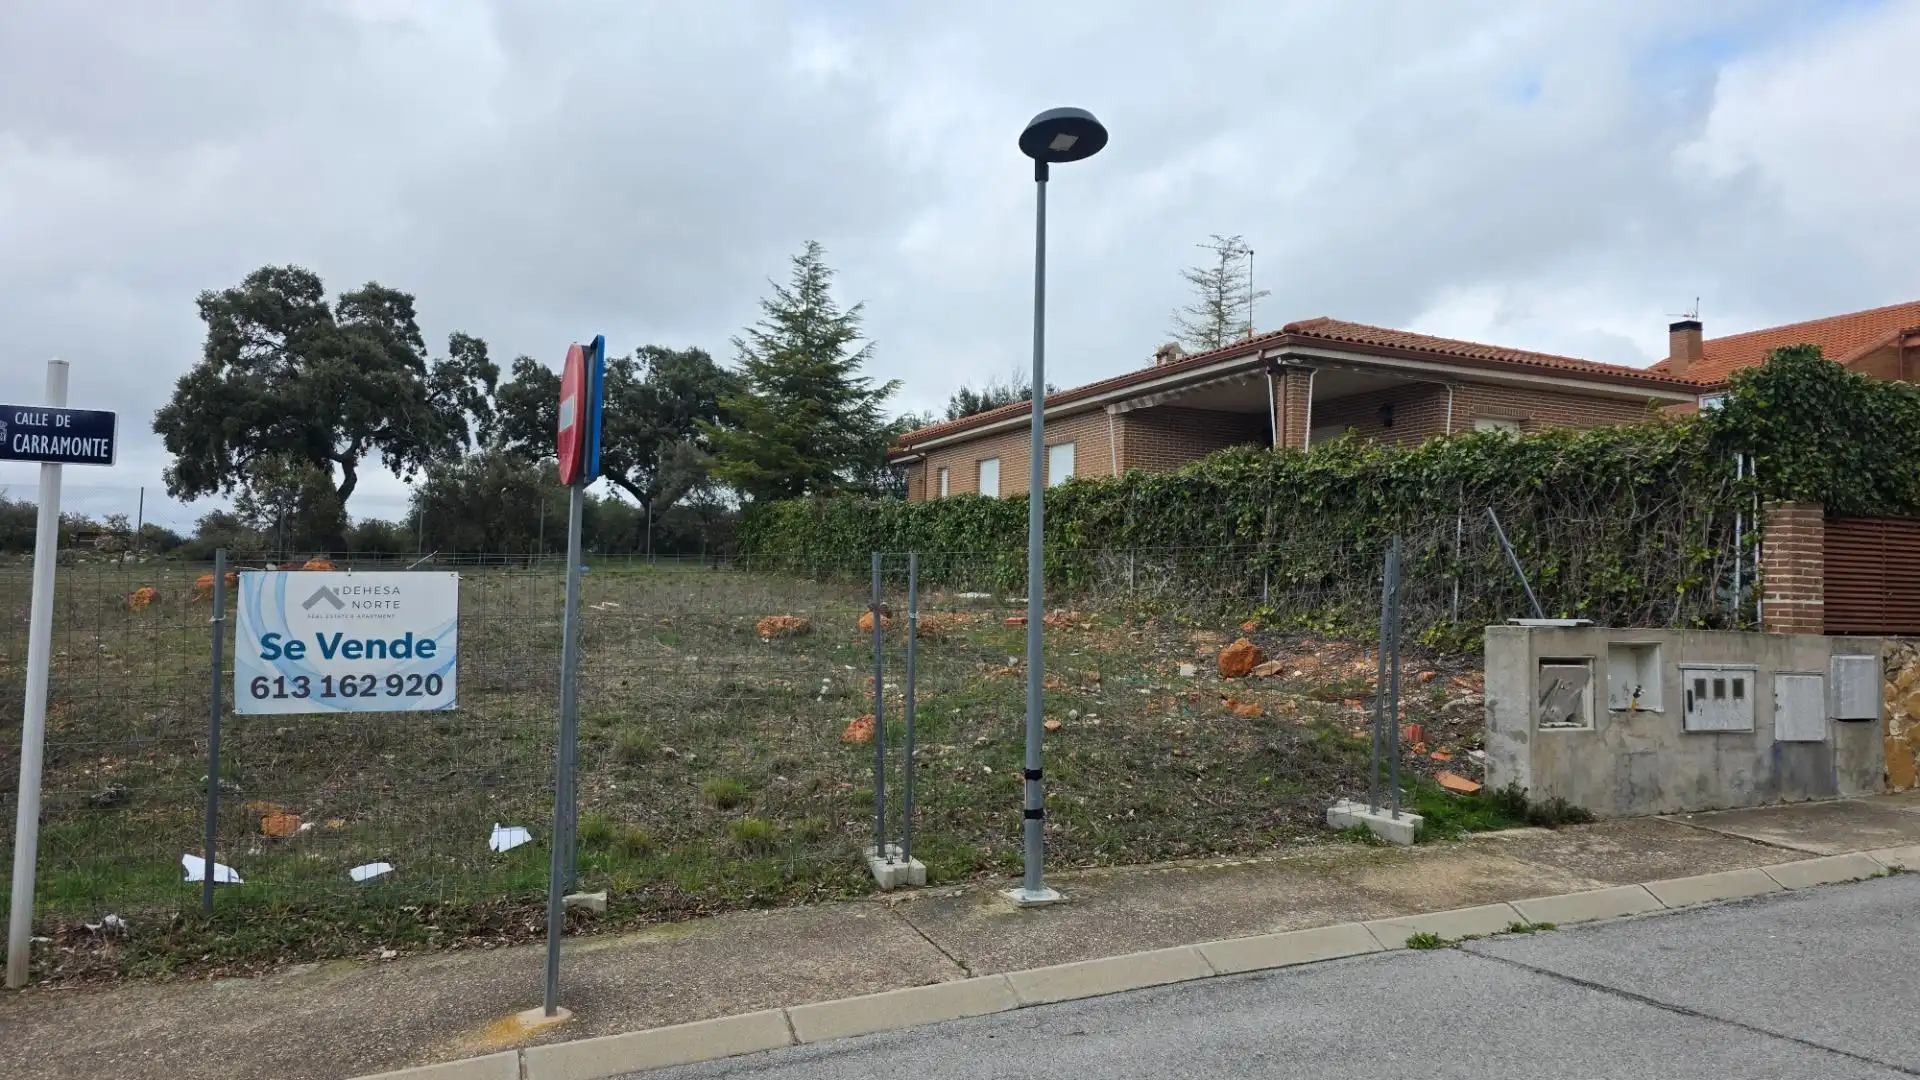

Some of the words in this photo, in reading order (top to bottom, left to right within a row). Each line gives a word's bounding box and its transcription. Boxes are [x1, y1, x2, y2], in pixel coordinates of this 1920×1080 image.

[14, 412, 49, 426] CALLE
[55, 414, 71, 427] DE
[13, 433, 109, 457] CARRAMONTE
[342, 586, 400, 595] DEHESA
[351, 600, 400, 609] NORTE
[259, 632, 306, 661] Se
[315, 631, 437, 660] Vende
[250, 675, 311, 700] 613
[320, 674, 377, 699] 162
[385, 673, 444, 698] 920
